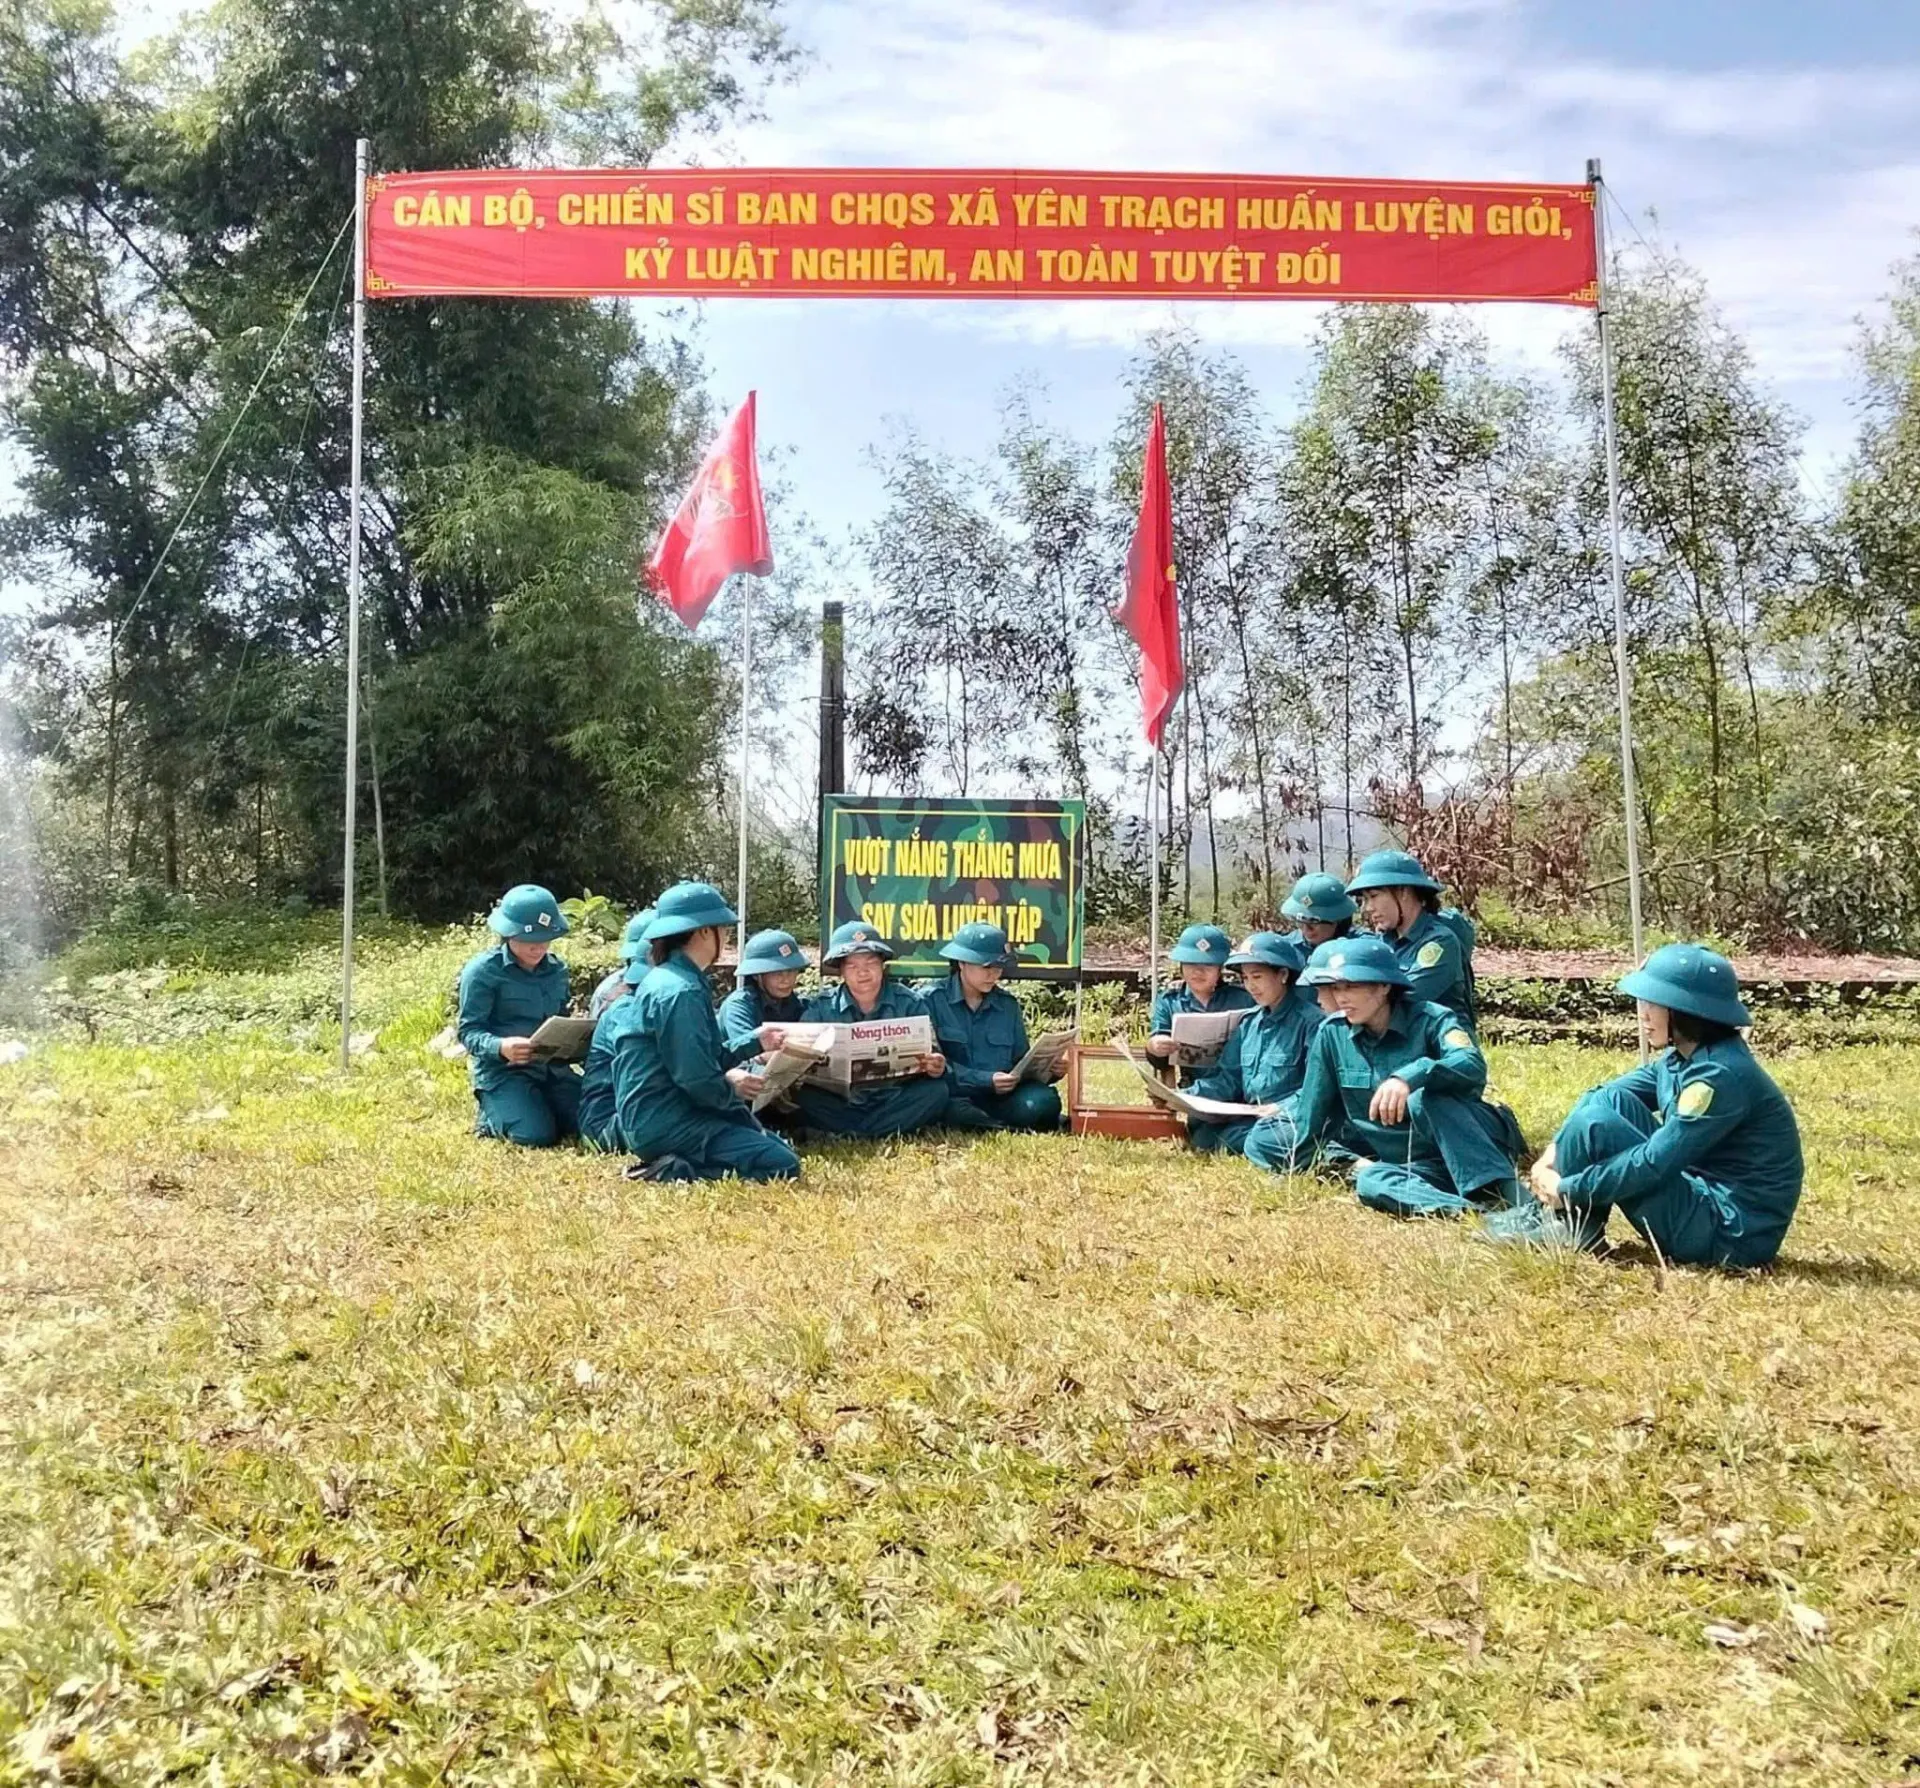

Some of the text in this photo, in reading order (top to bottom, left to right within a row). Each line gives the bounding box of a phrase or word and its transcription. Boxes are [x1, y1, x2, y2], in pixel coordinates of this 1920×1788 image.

[393, 183, 1573, 241] CÁN BỘ, CHIẾN SĨ BAN CHQS XÃ YÊN TRẠCH HUẤN LUYỆN GIỎI,
[624, 236, 1341, 290] KỶ LUẬT NGHIÊM, AN TOÀN TUYỆT ĐỐI
[843, 827, 1062, 885] VƯỢT NẮNG THẮNG MƯA
[900, 899, 938, 941] SƯA
[1006, 898, 1043, 951] TẬP
